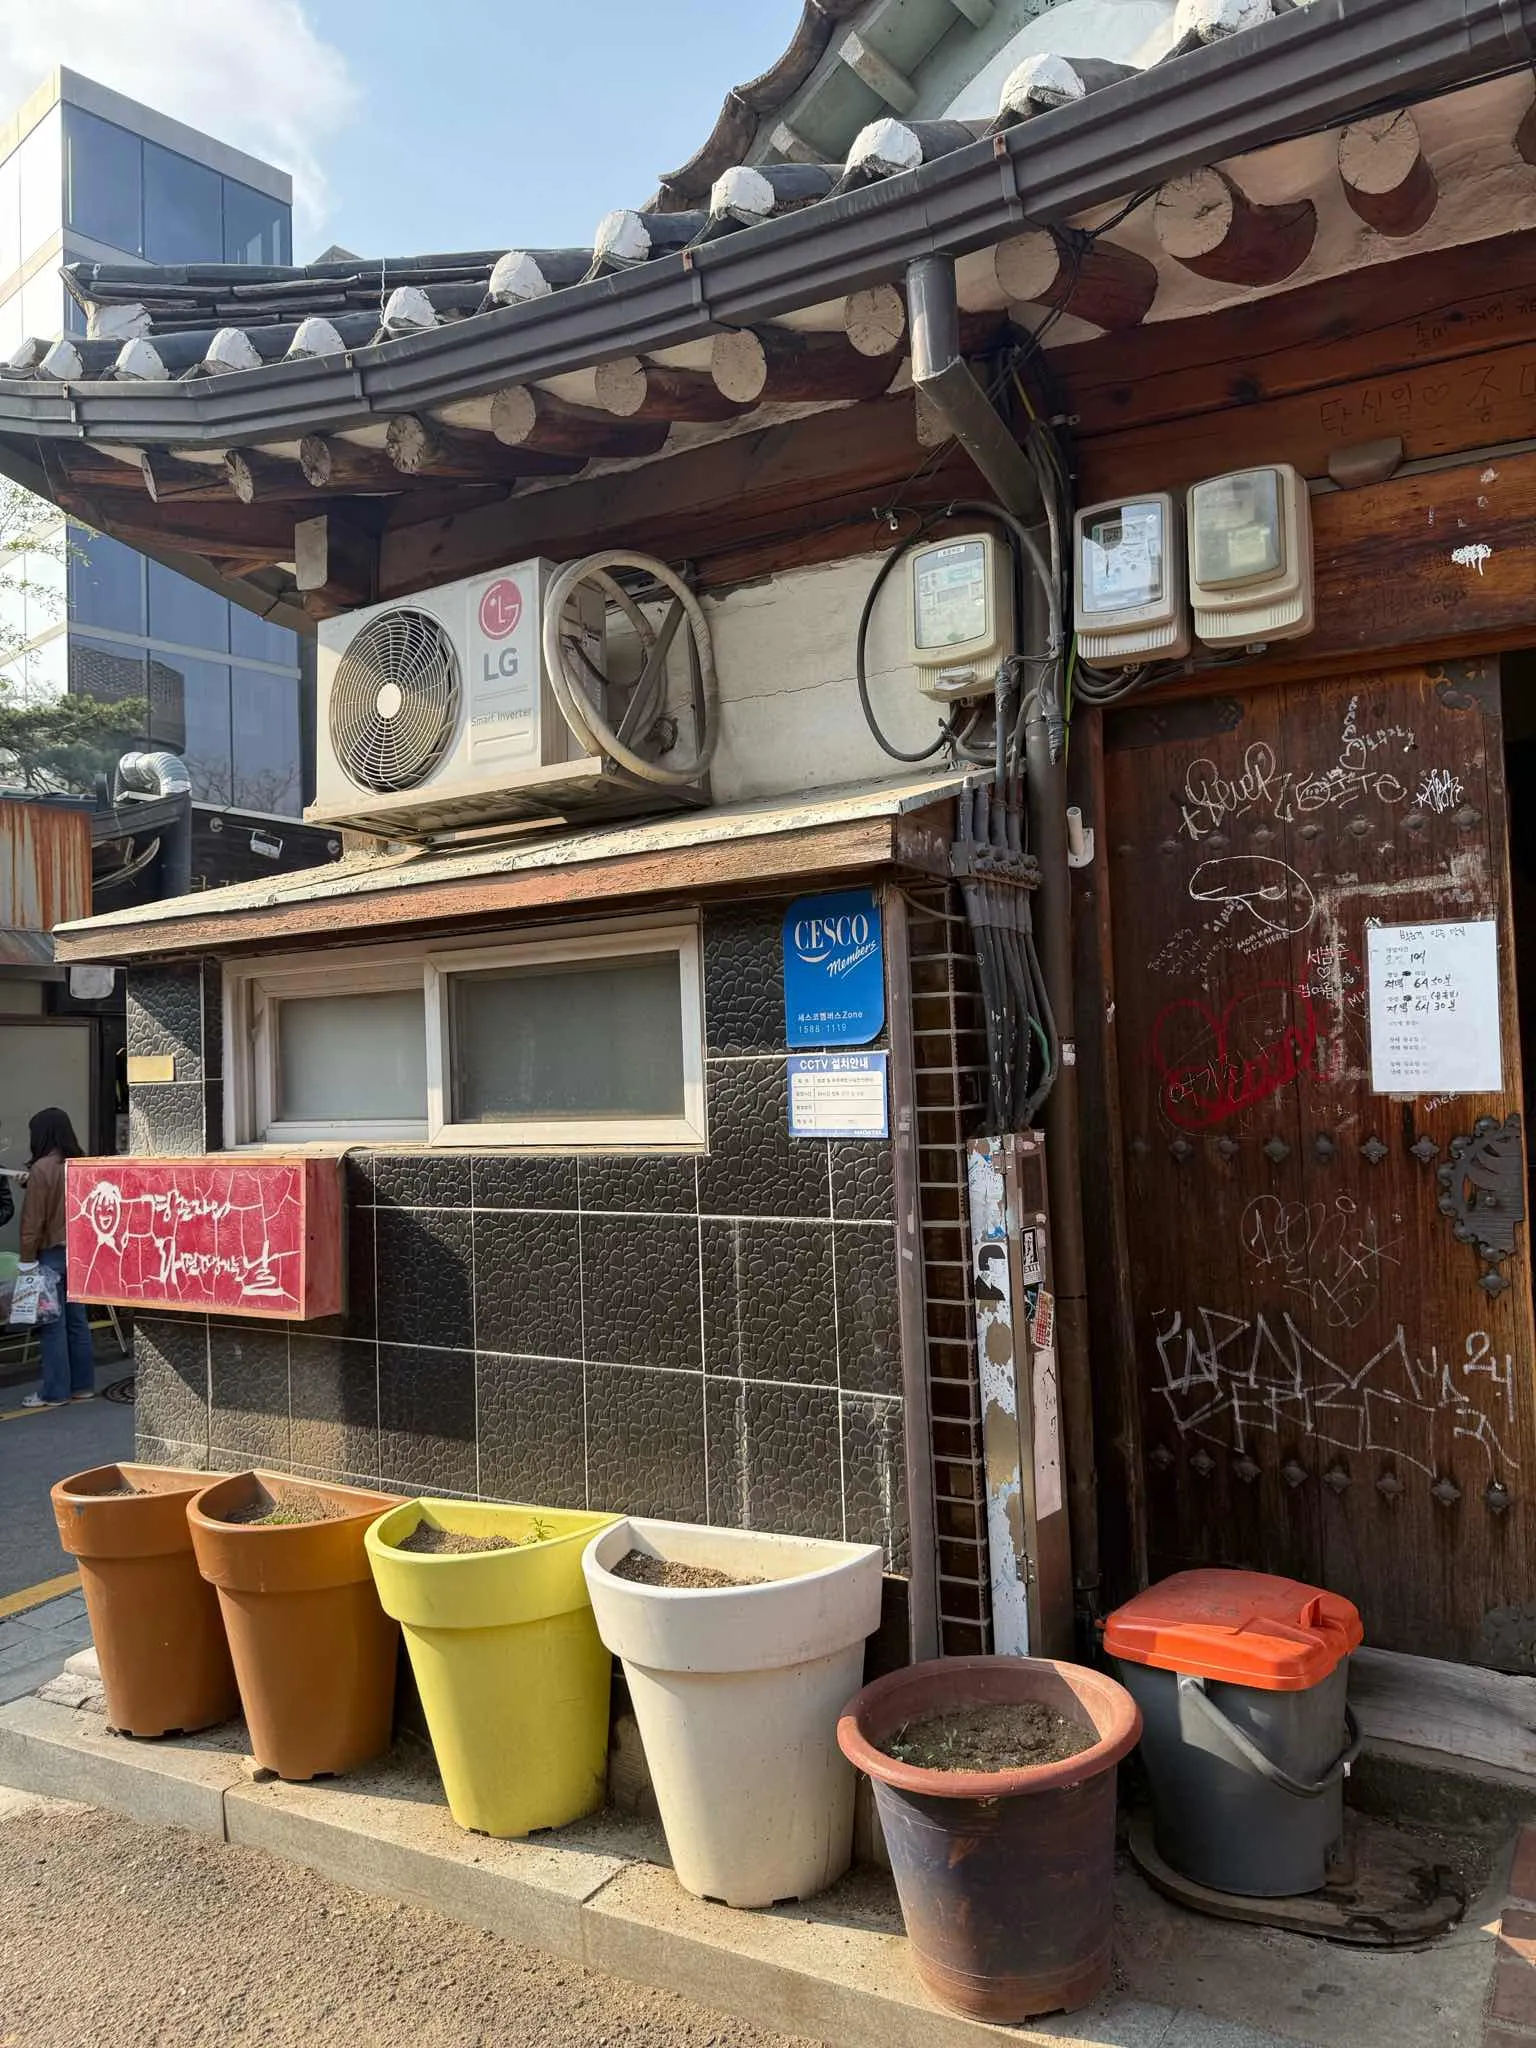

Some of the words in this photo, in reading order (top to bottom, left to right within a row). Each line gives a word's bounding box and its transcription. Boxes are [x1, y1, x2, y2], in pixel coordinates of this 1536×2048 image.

[483, 647, 519, 681] LG
[794, 913, 869, 951] CESCO
[826, 939, 877, 974] Members
[799, 1058, 829, 1071] CCTV
[830, 1056, 870, 1071] 설치안내
